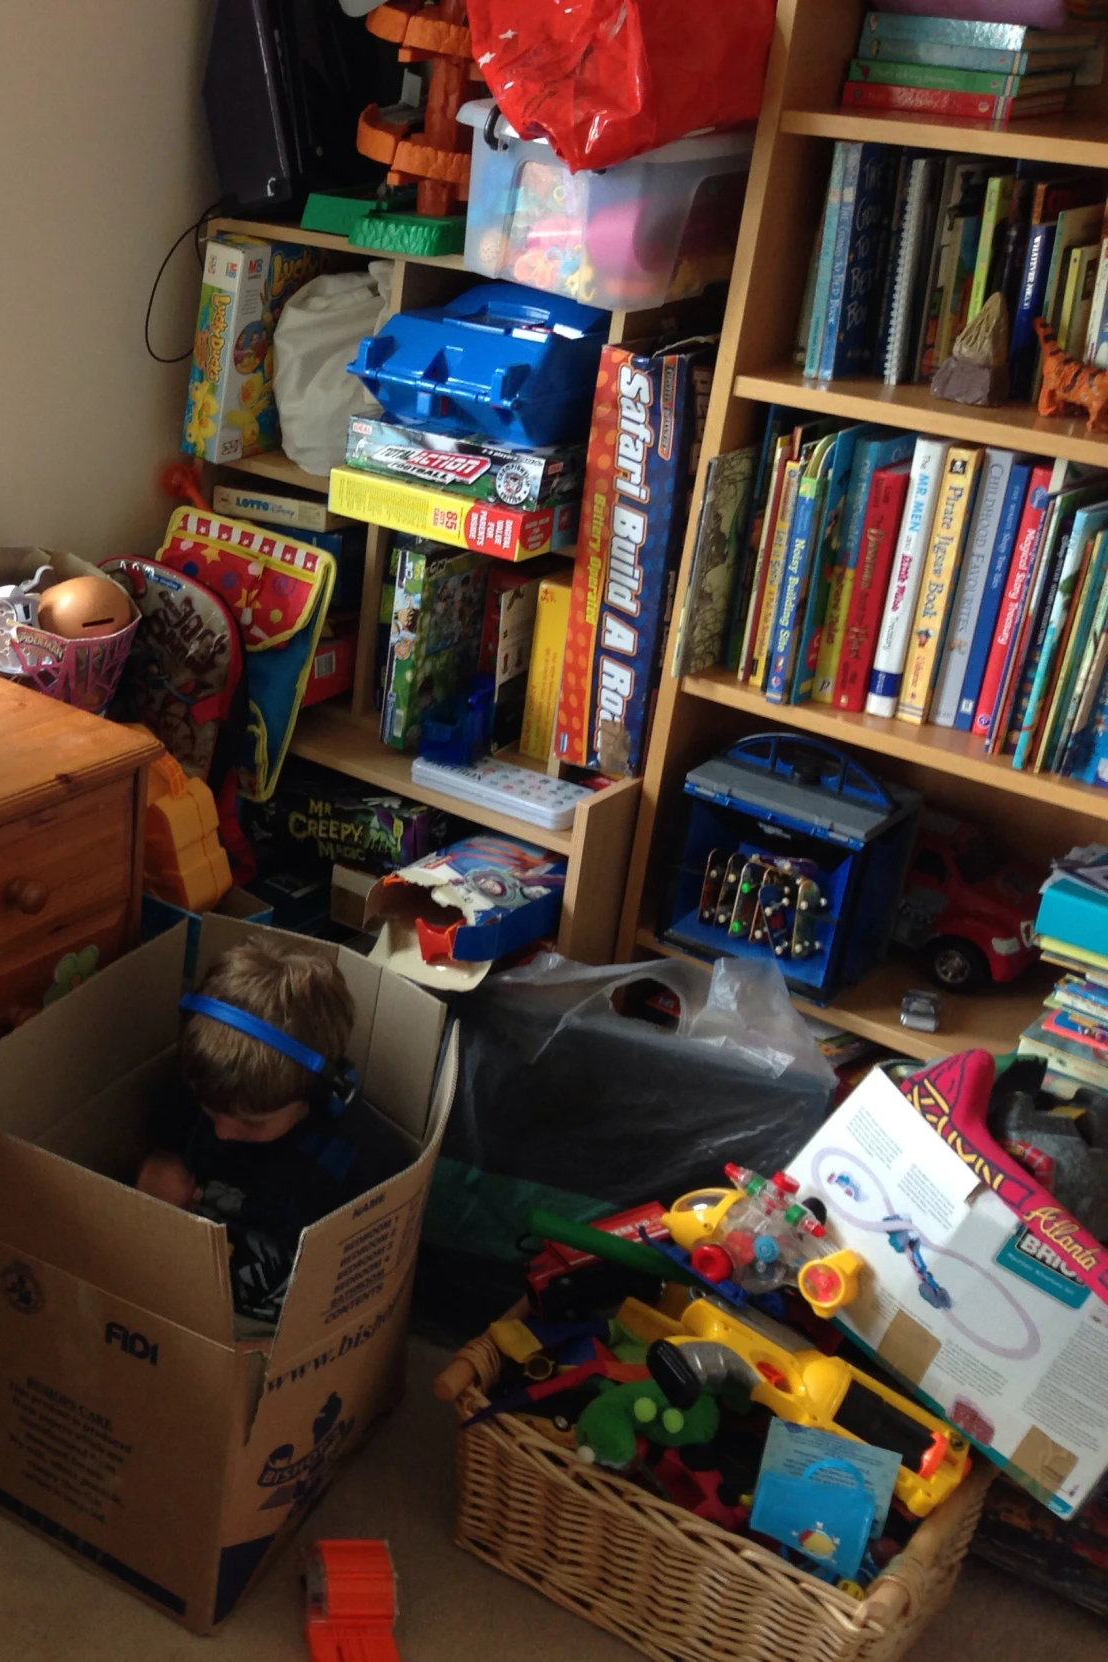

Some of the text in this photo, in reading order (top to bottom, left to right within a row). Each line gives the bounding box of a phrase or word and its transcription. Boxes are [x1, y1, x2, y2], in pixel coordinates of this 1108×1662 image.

[248, 258, 263, 274] MB
[616, 366, 653, 502] Safari
[391, 461, 451, 481] FOOTBALL
[409, 451, 482, 475] ACTION
[920, 455, 931, 471] The
[914, 473, 930, 501] MR.
[236, 496, 270, 513] LOTTO
[444, 510, 458, 531] 85
[909, 502, 924, 533] MEN
[469, 512, 478, 539] INSIDE
[477, 510, 488, 546] PARENTS
[486, 522, 495, 539] FOR
[494, 520, 504, 546] VALUE
[502, 519, 513, 549] DIGITAL
[585, 493, 605, 625] Battery Operated
[606, 505, 647, 616] Build
[788, 538, 806, 575] Noisy
[922, 485, 963, 619] Pirate Jigsaw Book
[958, 463, 1004, 634] CHILDHOOD FAVOURITES
[1018, 528, 1037, 568] Magical
[1007, 569, 1025, 600] Story
[779, 576, 800, 628] Building
[601, 613, 637, 656] A
[777, 629, 790, 653] Site
[997, 602, 1020, 647] Treasury
[308, 798, 333, 816] MR
[288, 812, 364, 842] CREEPY
[317, 839, 367, 863] MAGIC
[352, 1193, 386, 1220] NAME
[339, 1234, 388, 1267] BEDROOM
[342, 1220, 392, 1253] BEDROOM
[1024, 1206, 1100, 1271] Atlanta
[333, 1261, 382, 1294] BEDROOM
[336, 1248, 385, 1281] BEDROOM
[324, 1282, 384, 1325] CONTENTS
[330, 1270, 385, 1308] BATHROOM
[105, 1322, 159, 1366] FIDI
